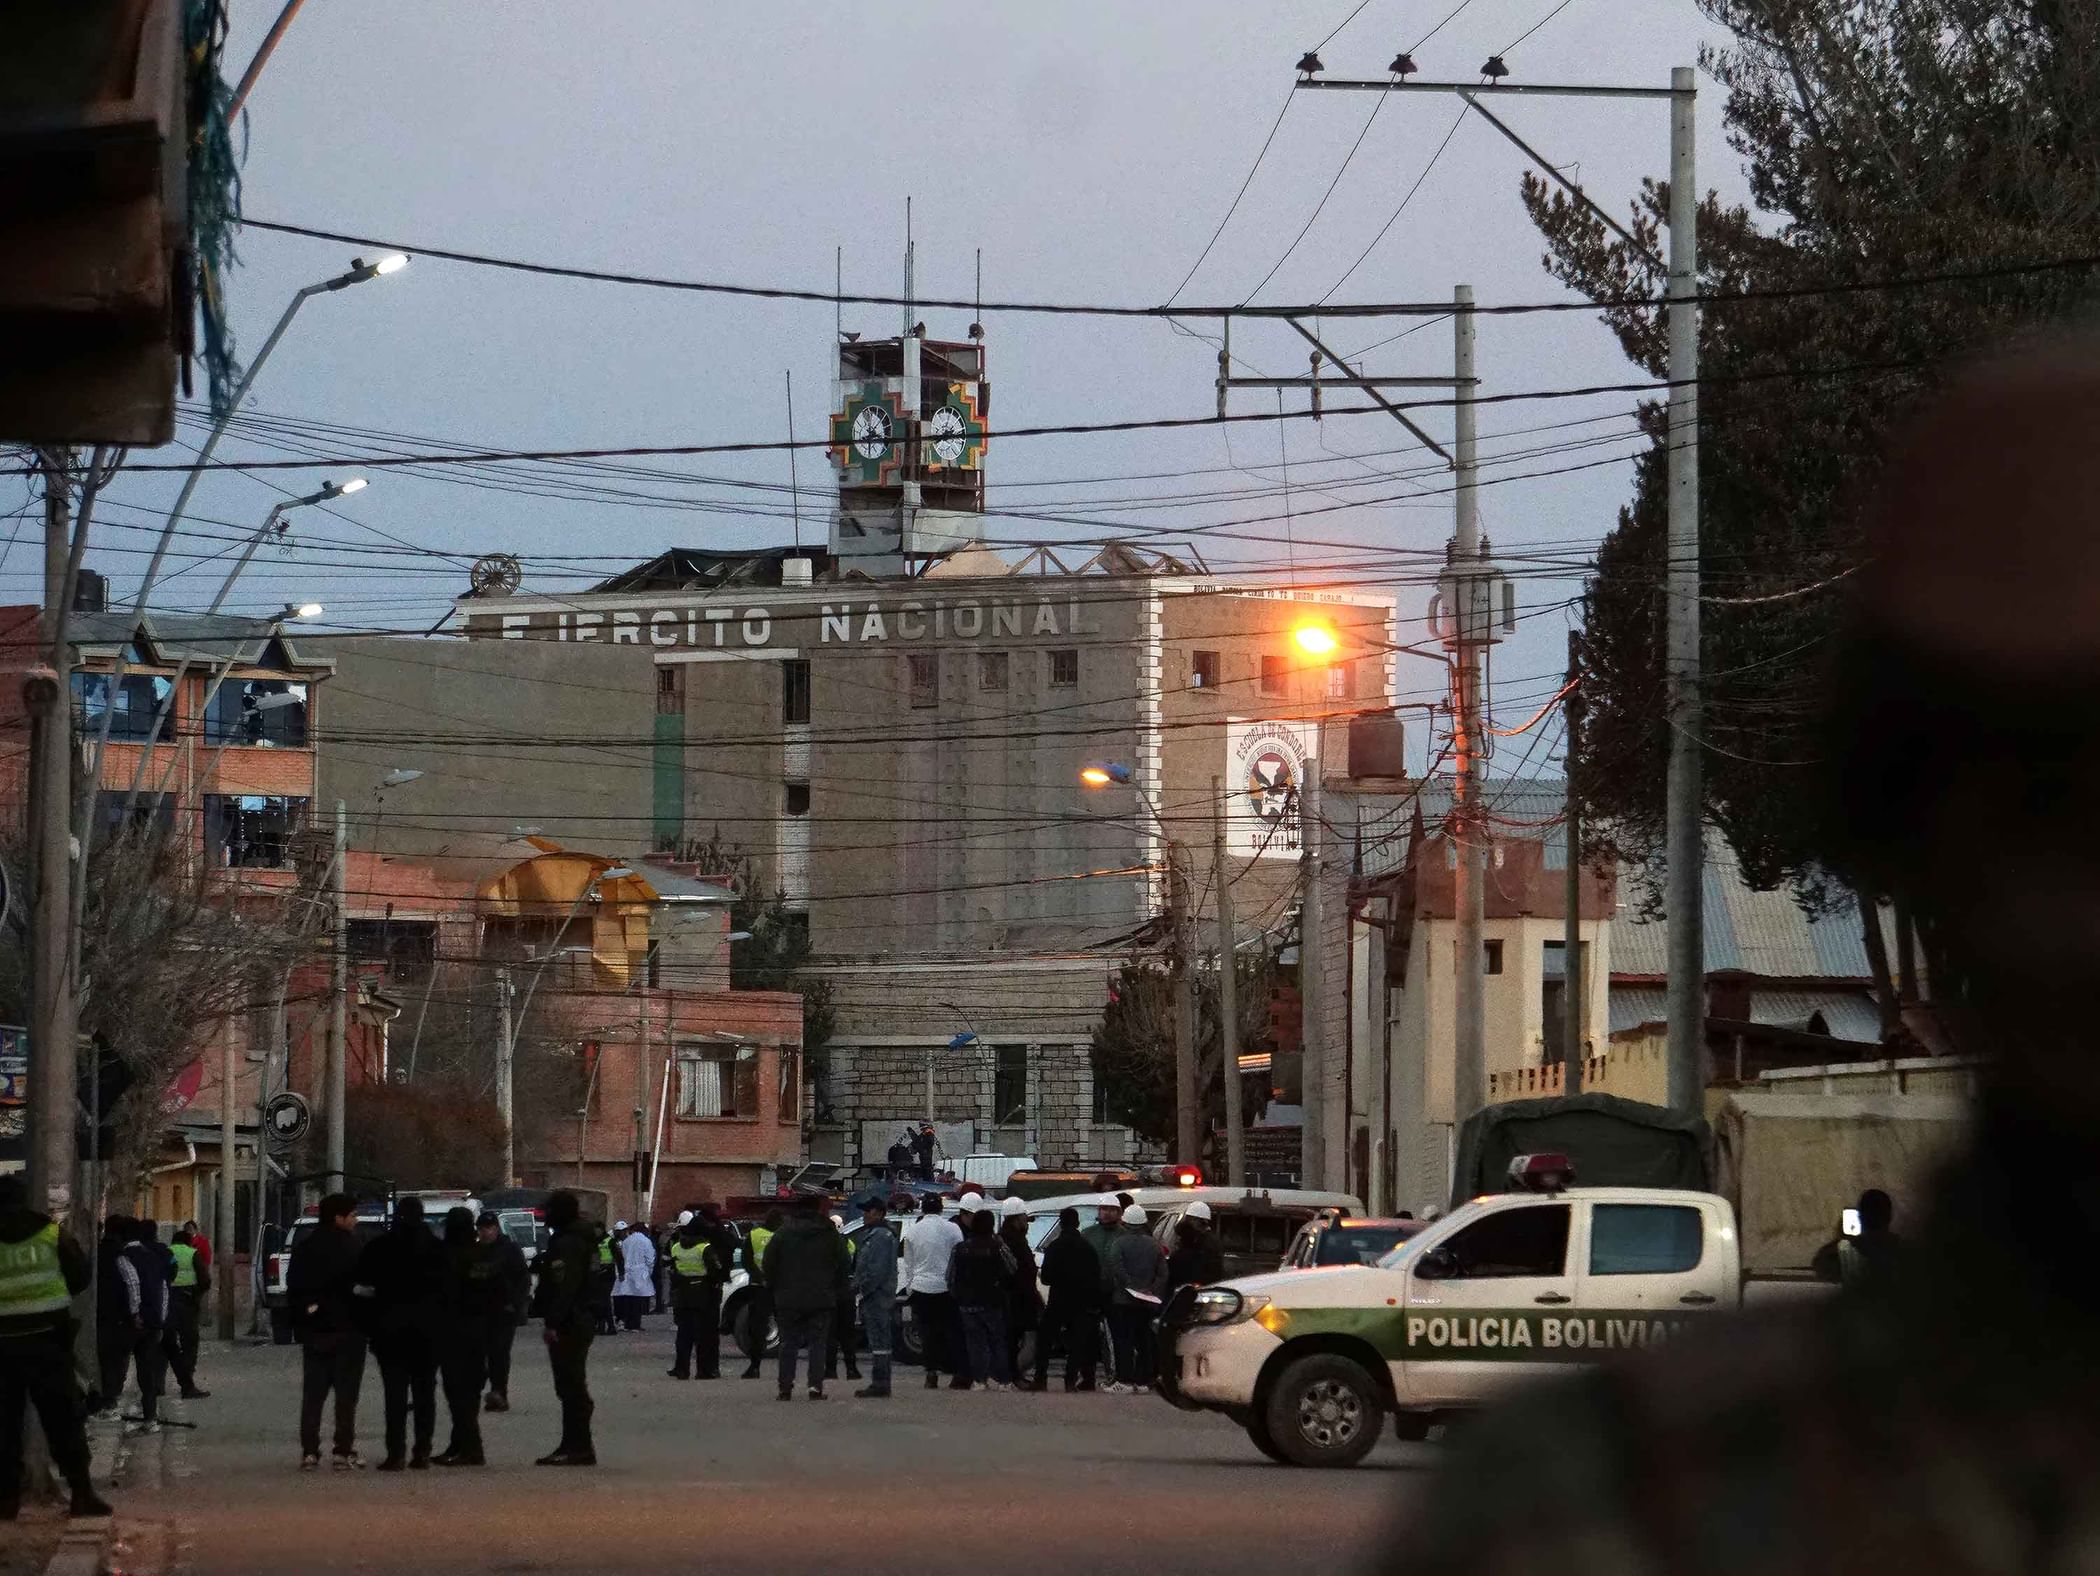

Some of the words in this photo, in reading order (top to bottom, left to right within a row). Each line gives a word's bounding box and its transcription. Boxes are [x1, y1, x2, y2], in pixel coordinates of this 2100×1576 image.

[821, 596, 1101, 642] NACIONAL
[1236, 723, 1267, 761] ESCUELA
[1408, 1317, 1532, 1348] POLICIA
[1543, 1318, 1690, 1349] BOLIVIA
